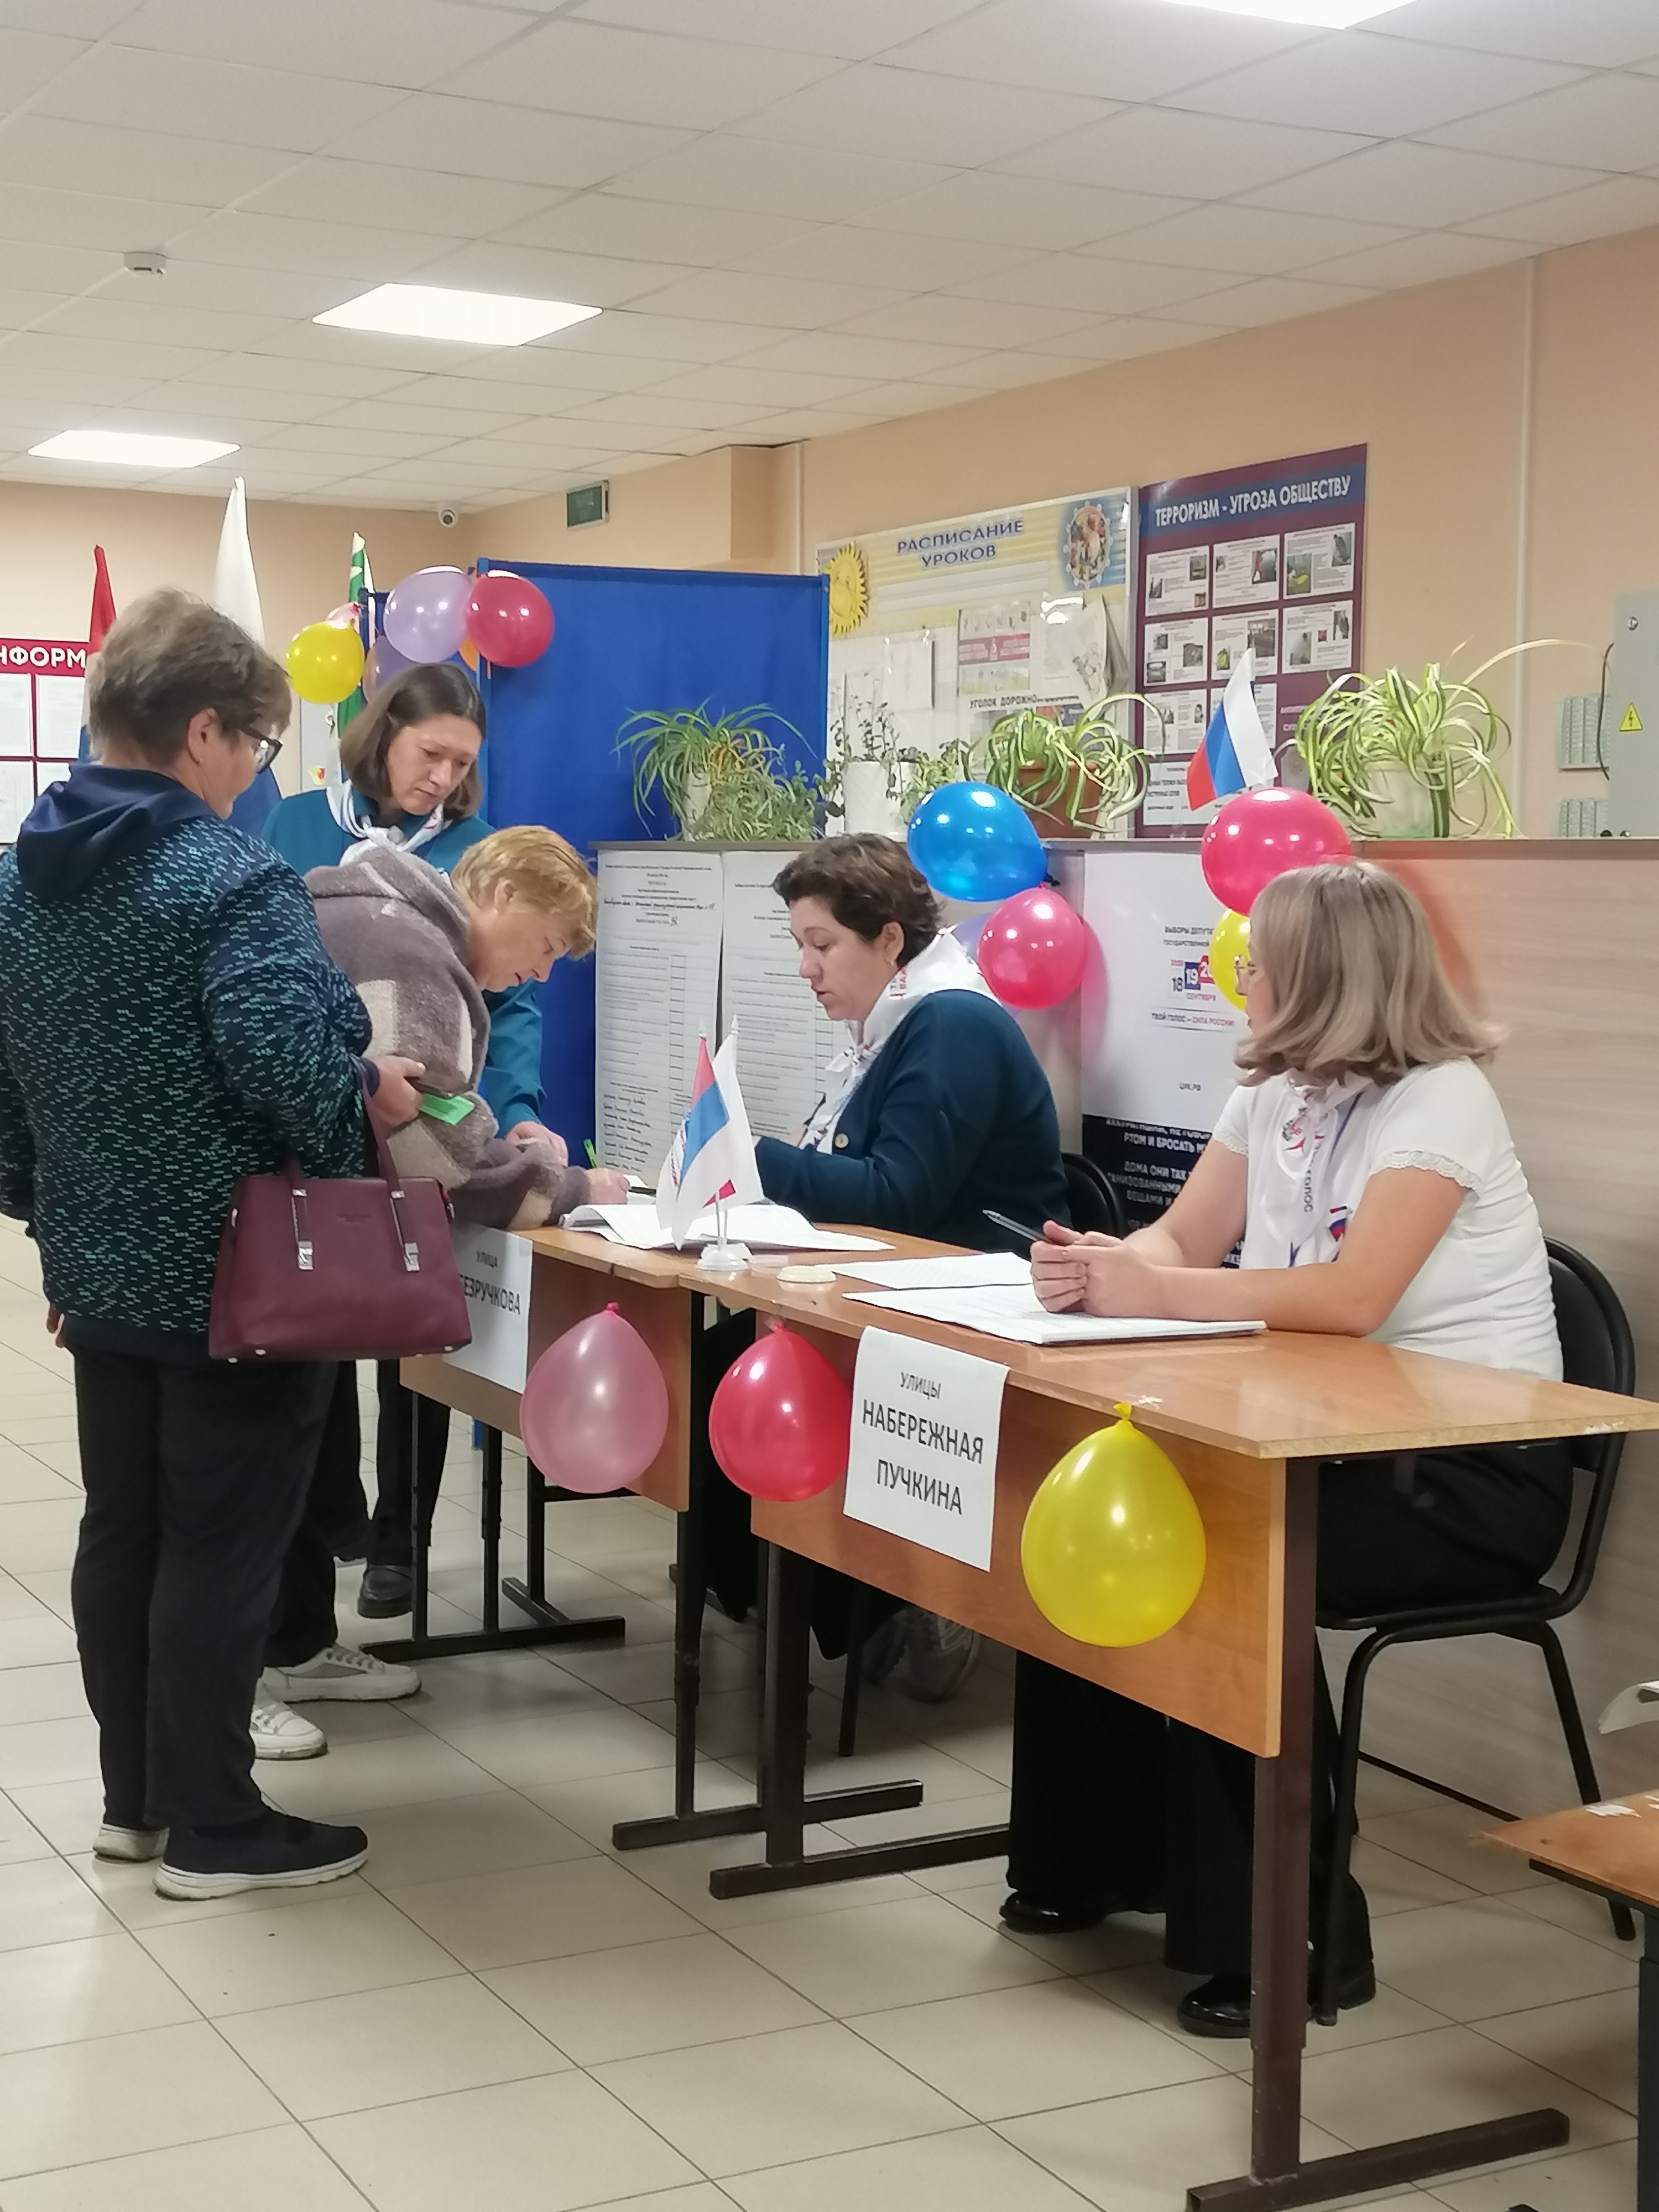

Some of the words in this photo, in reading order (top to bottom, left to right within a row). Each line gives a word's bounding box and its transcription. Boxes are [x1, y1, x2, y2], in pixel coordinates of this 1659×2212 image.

[1155, 498, 1220, 527] ТЕРРОРИЗМ
[1229, 489, 1277, 514] УГРОЗА
[1279, 475, 1351, 505] ОБЩЕСТВУ
[898, 520, 1023, 553] РАСПИСАНИЕ
[921, 545, 996, 567] УРОКОВ
[970, 698, 997, 708] УГОЛОК
[1172, 977, 1183, 992] 18
[1186, 968, 1198, 985] 19
[458, 1273, 520, 1315] ЕЗРУЧКОВА
[900, 1371, 941, 1400] УЛИЦЫ
[862, 1399, 984, 1464] НАБЕРЕЖНАЯ
[877, 1459, 963, 1515] ПУЧКИНА
